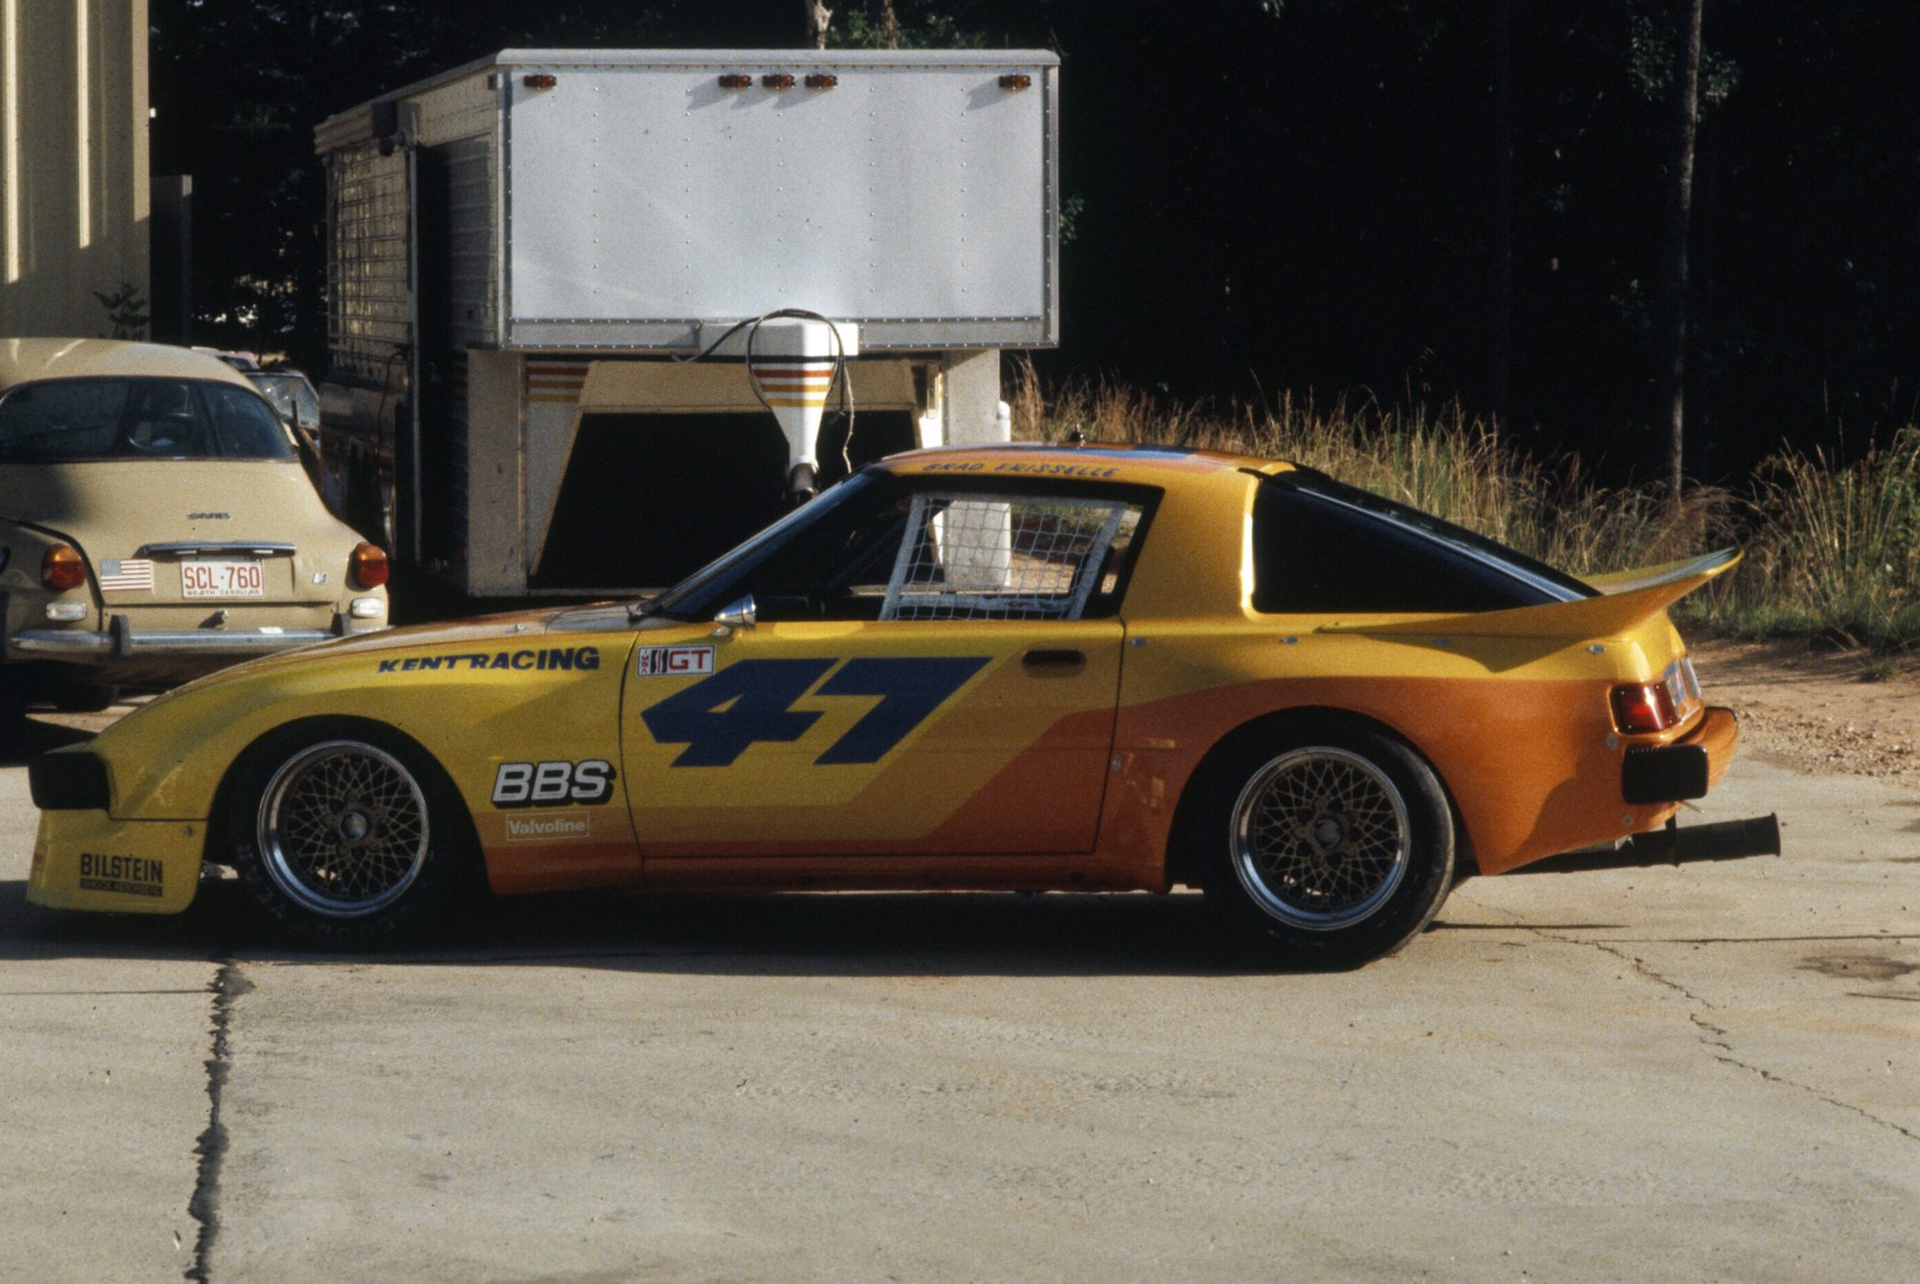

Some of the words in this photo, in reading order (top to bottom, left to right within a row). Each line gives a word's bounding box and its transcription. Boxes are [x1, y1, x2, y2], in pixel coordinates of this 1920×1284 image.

[923, 462, 985, 472] BRAD
[669, 650, 710, 670] GT
[640, 657, 994, 767] 47
[491, 759, 616, 808] BBS
[509, 819, 585, 834] Valvoline
[81, 853, 163, 883] BILSTEIN
